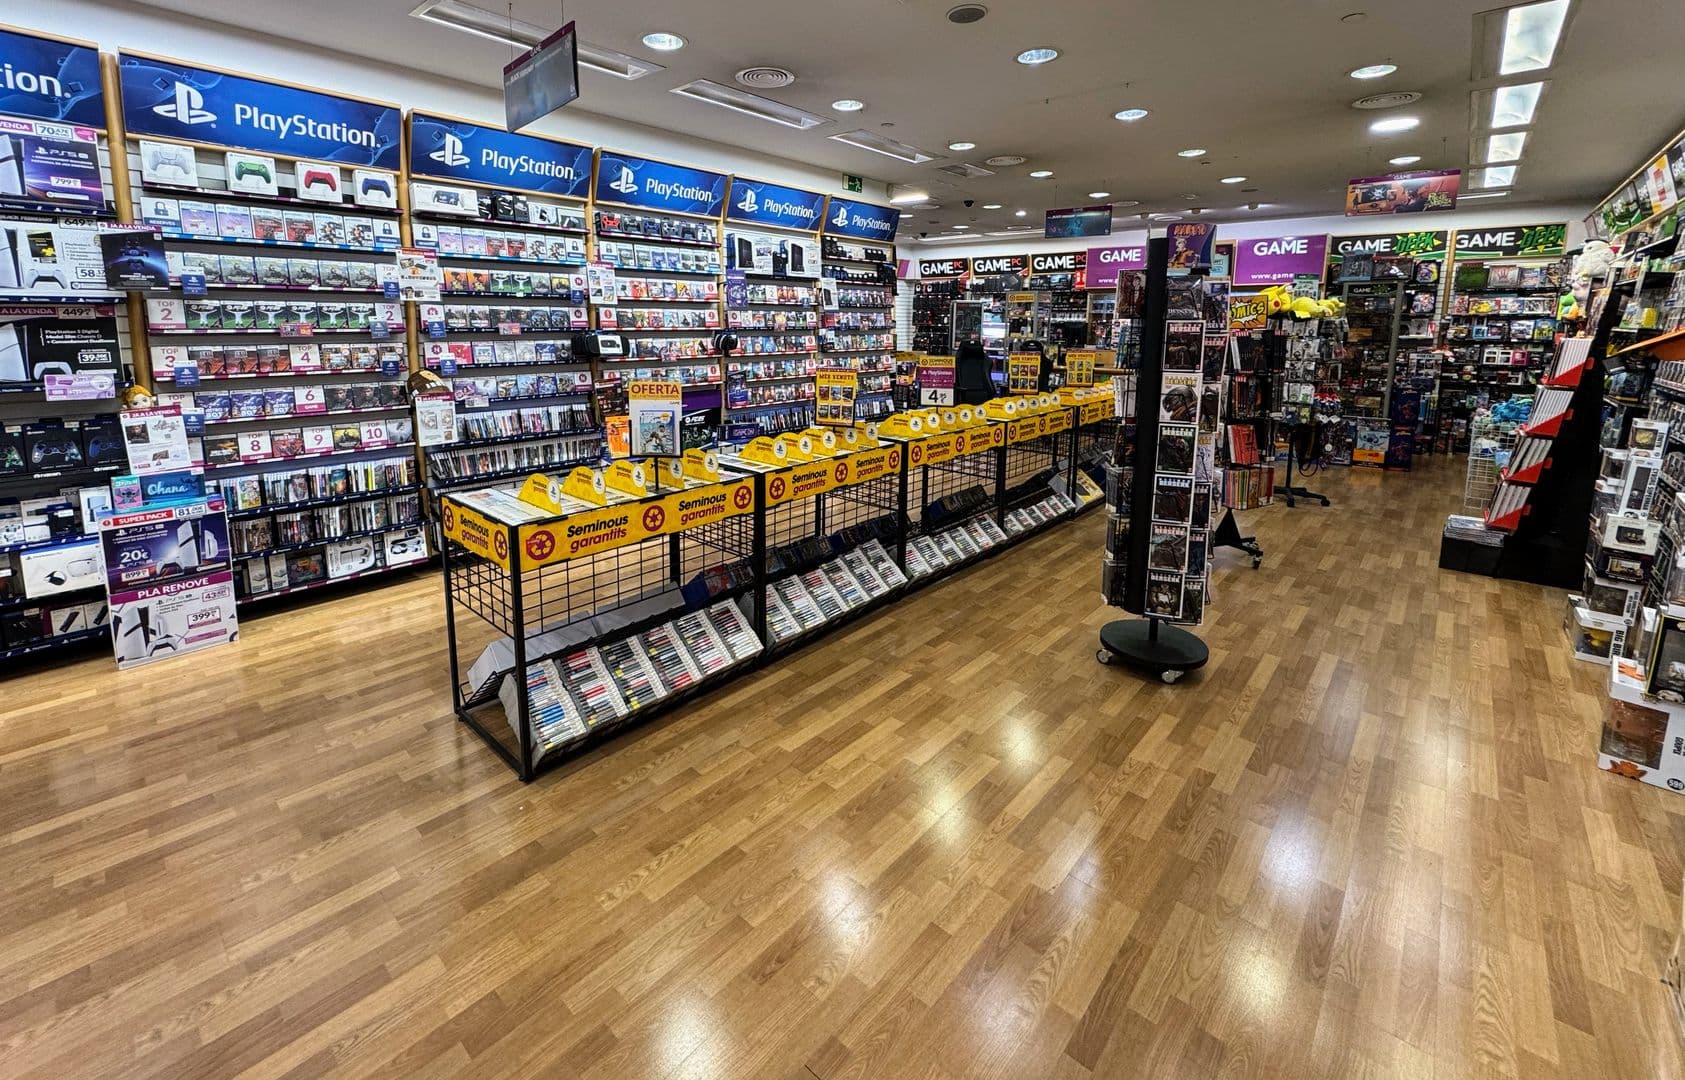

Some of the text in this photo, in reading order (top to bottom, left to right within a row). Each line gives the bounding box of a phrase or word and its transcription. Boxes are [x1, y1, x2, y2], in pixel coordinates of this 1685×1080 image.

[0, 63, 71, 98] ion
[64, 218, 85, 226] 649
[1338, 238, 1392, 254] GAME
[1455, 232, 1516, 248] GAME
[1253, 239, 1308, 256] GAME
[1033, 255, 1075, 269] GAME
[1100, 249, 1141, 263] GAME
[921, 262, 953, 274] GAME
[974, 259, 1011, 272] GAME
[80, 269, 95, 278] 58
[63, 307, 83, 315] 449
[161, 308, 173, 320] 2
[385, 311, 394, 321] 2
[301, 352, 311, 363] 4
[305, 390, 315, 401] 6
[631, 384, 680, 395] OFERTA
[928, 390, 938, 403] 4
[314, 434, 323, 445] 9
[366, 429, 382, 439] 10
[970, 432, 990, 441] Seminous
[250, 440, 261, 452] 8
[926, 441, 950, 452] Seminous
[856, 455, 885, 468] Seminous
[792, 469, 827, 484] Seminous
[856, 465, 884, 479] garantits
[147, 481, 189, 495] Ohana
[793, 477, 826, 496] garantits
[678, 492, 727, 511] Seminous
[118, 512, 168, 524] SUPER PACK
[681, 504, 725, 525] garantits
[460, 515, 489, 537] Seminous
[567, 515, 629, 538] Seminous
[462, 529, 489, 550] garantits
[570, 528, 627, 553] garantits
[137, 578, 209, 599] PLA RENOVE
[192, 612, 211, 622] 399
